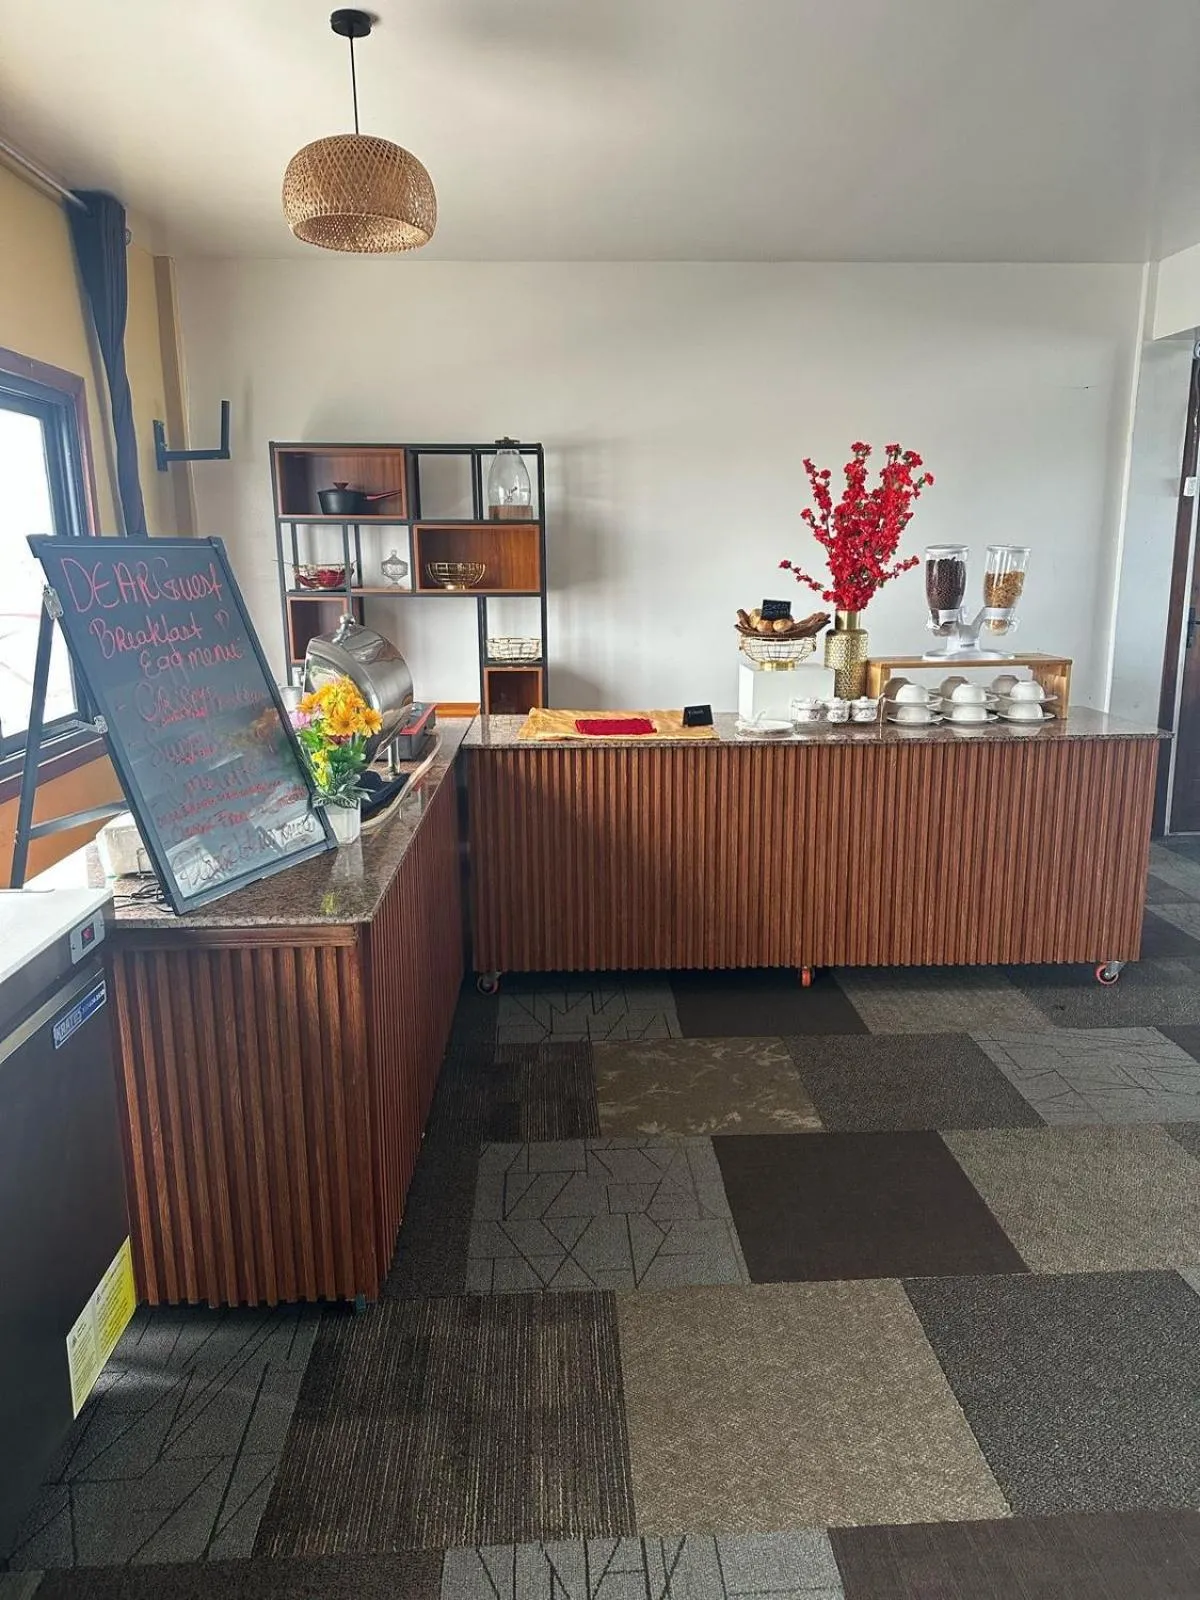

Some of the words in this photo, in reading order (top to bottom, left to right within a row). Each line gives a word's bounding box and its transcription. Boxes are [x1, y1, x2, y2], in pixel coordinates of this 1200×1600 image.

[61, 558, 159, 612] DEAR
[152, 557, 223, 602] Guest
[89, 612, 203, 660] Breakfast
